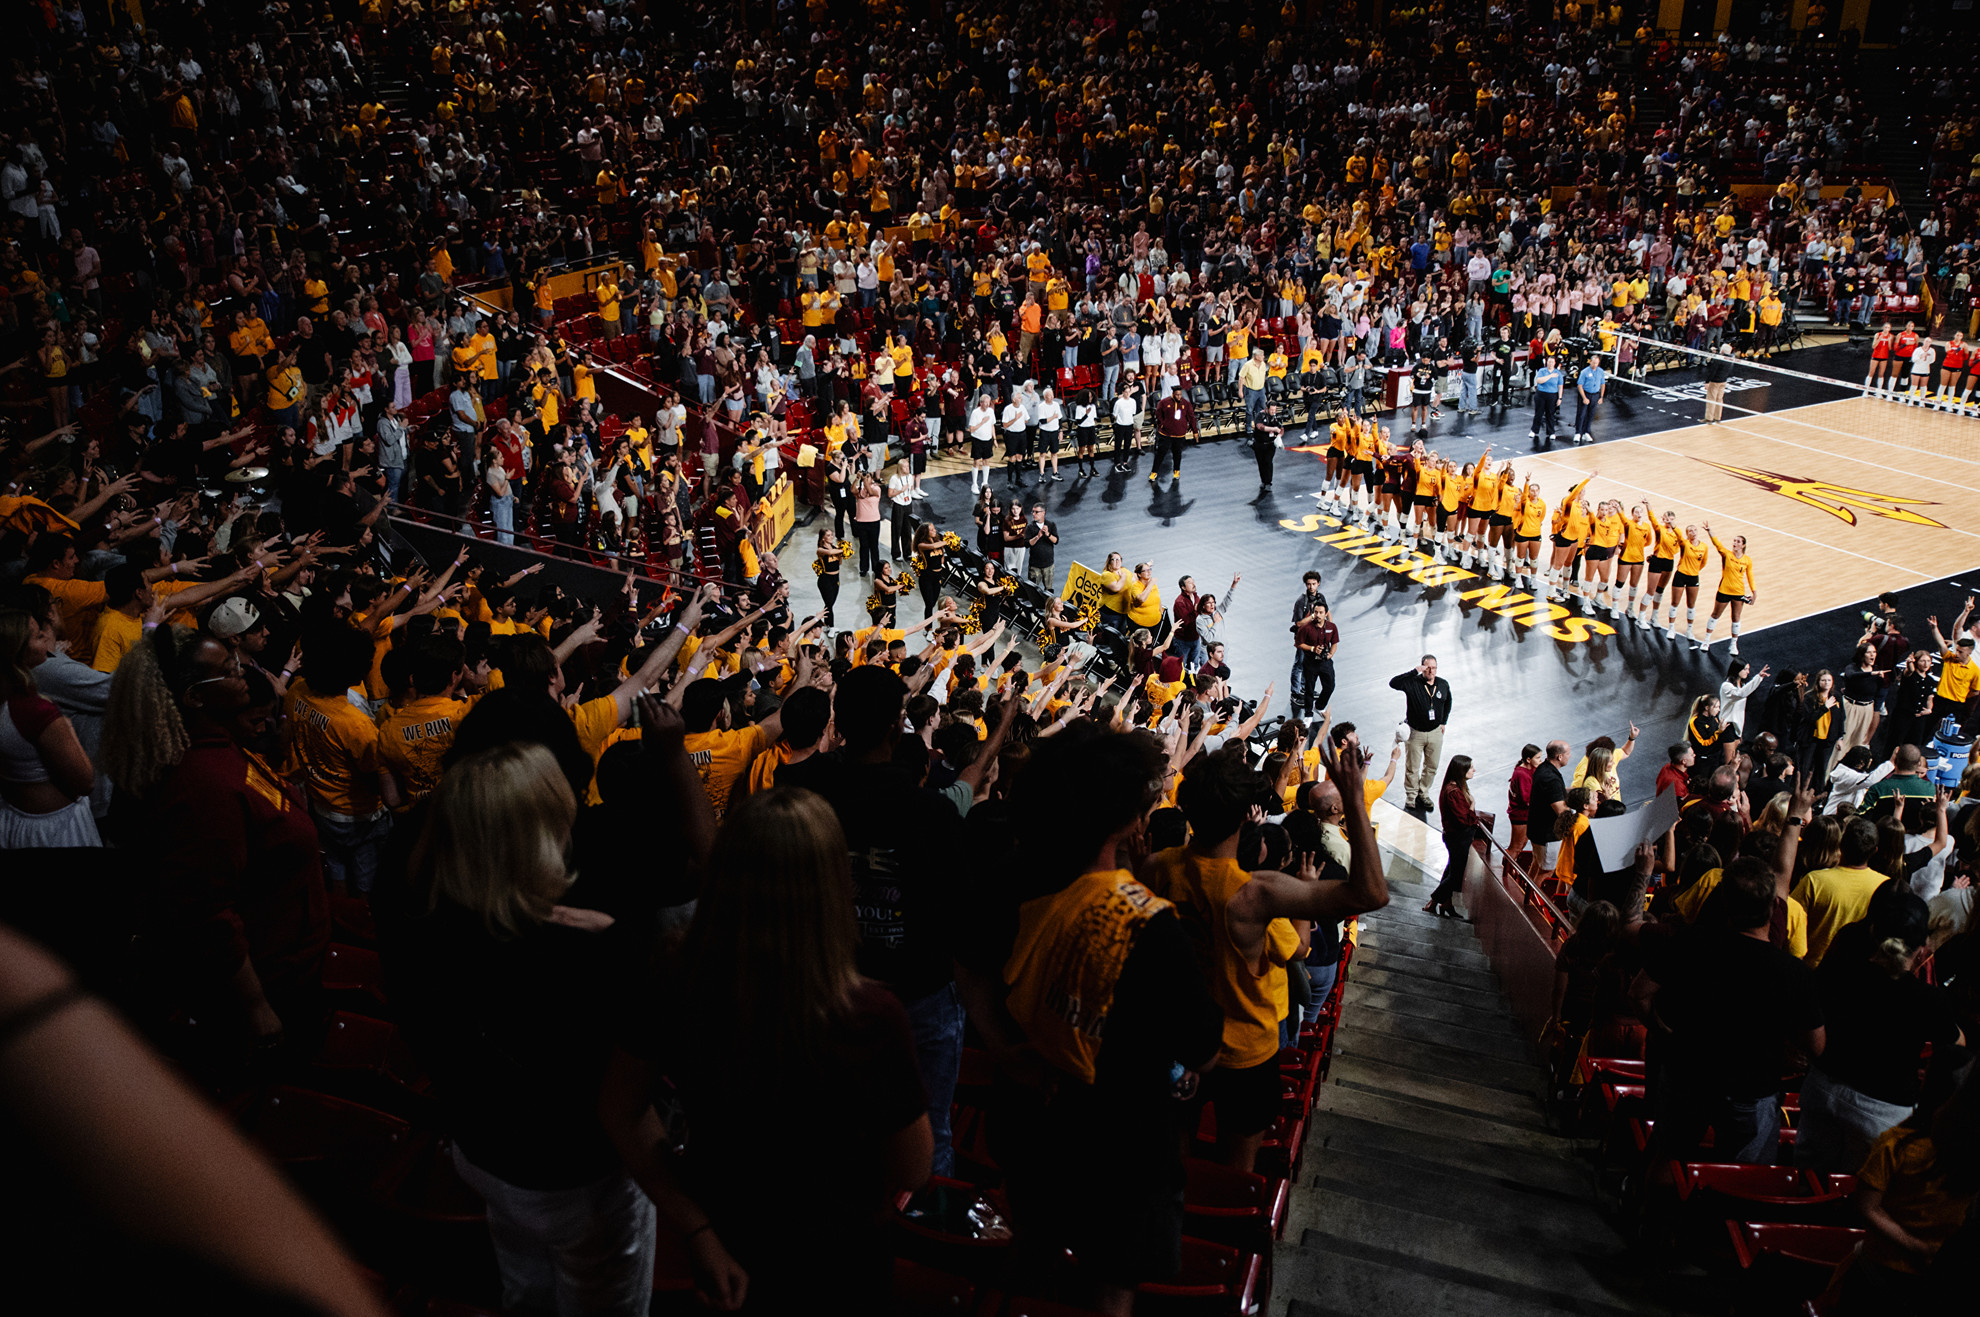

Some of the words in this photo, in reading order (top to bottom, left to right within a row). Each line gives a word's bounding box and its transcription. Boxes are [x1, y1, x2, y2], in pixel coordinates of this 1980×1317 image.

[756, 514, 776, 554] RNO
[1279, 515, 1479, 587] DEVILS
[1075, 571, 1103, 599] dese
[1457, 584, 1617, 642] SUN
[294, 697, 309, 719] WE
[309, 708, 331, 732] RUN
[402, 723, 424, 742] WE
[424, 717, 452, 738] RUN
